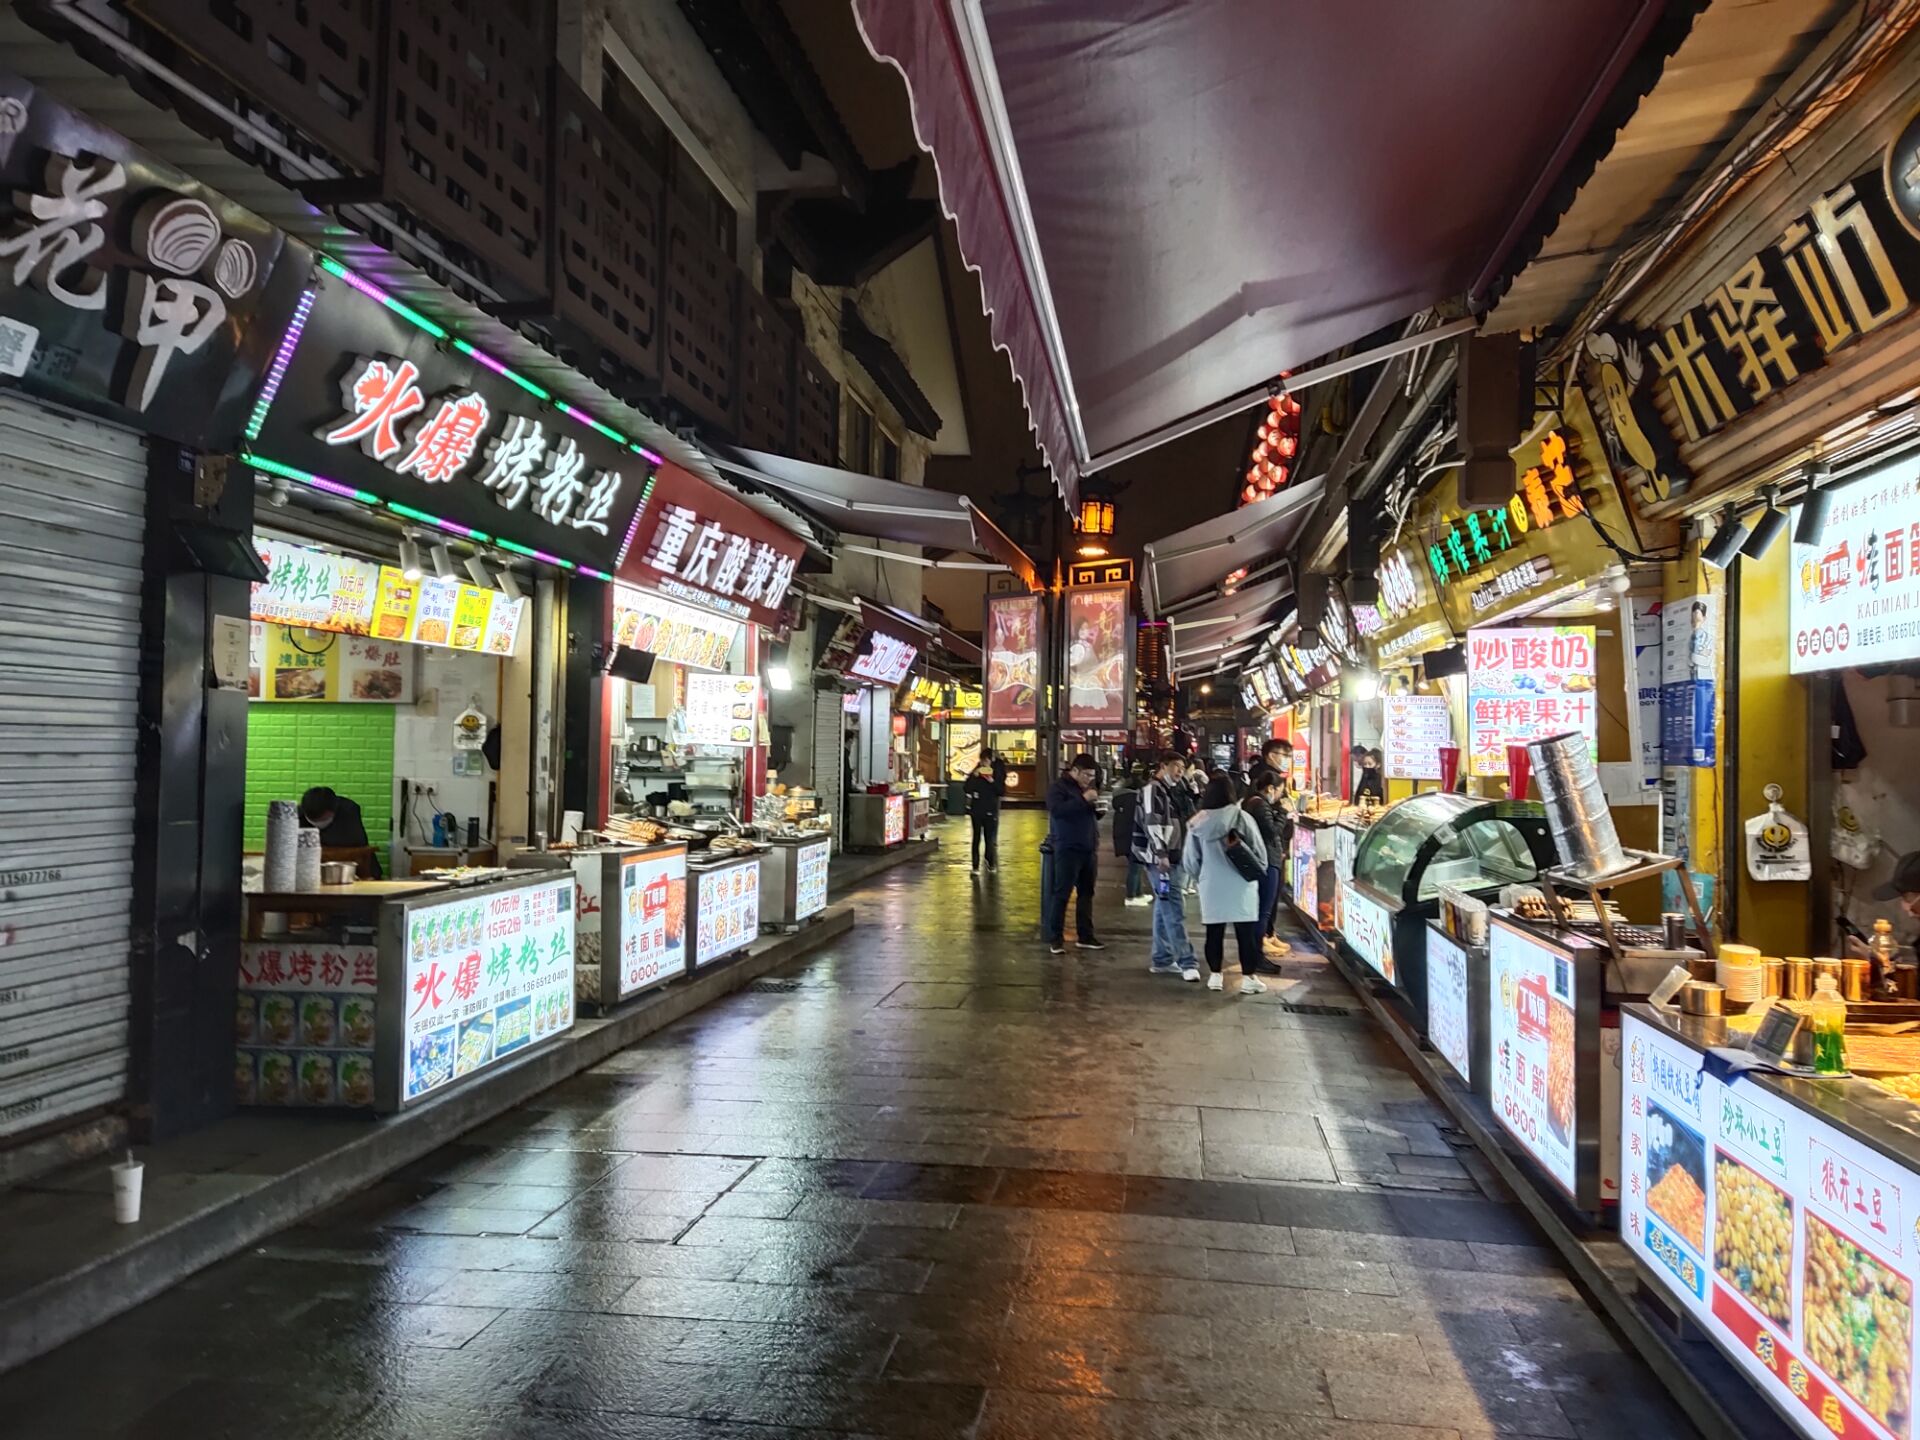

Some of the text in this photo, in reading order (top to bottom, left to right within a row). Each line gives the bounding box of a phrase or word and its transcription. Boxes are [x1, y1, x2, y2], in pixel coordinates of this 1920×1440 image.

[0, 158, 228, 414] 花甲
[1648, 182, 1908, 442] 米驿站
[326, 359, 622, 537] 火爆烤粉丝
[650, 504, 797, 611] 重庆酸辣粉
[1472, 635, 1589, 671] 炒酸奶
[1474, 697, 1592, 726] 鲜榨果汁
[486, 916, 521, 940] 15元2份
[489, 895, 520, 916] 10元/份
[1721, 1096, 1786, 1166] 珍珠小土豆
[1821, 1156, 1888, 1235] 狼牙土豆
